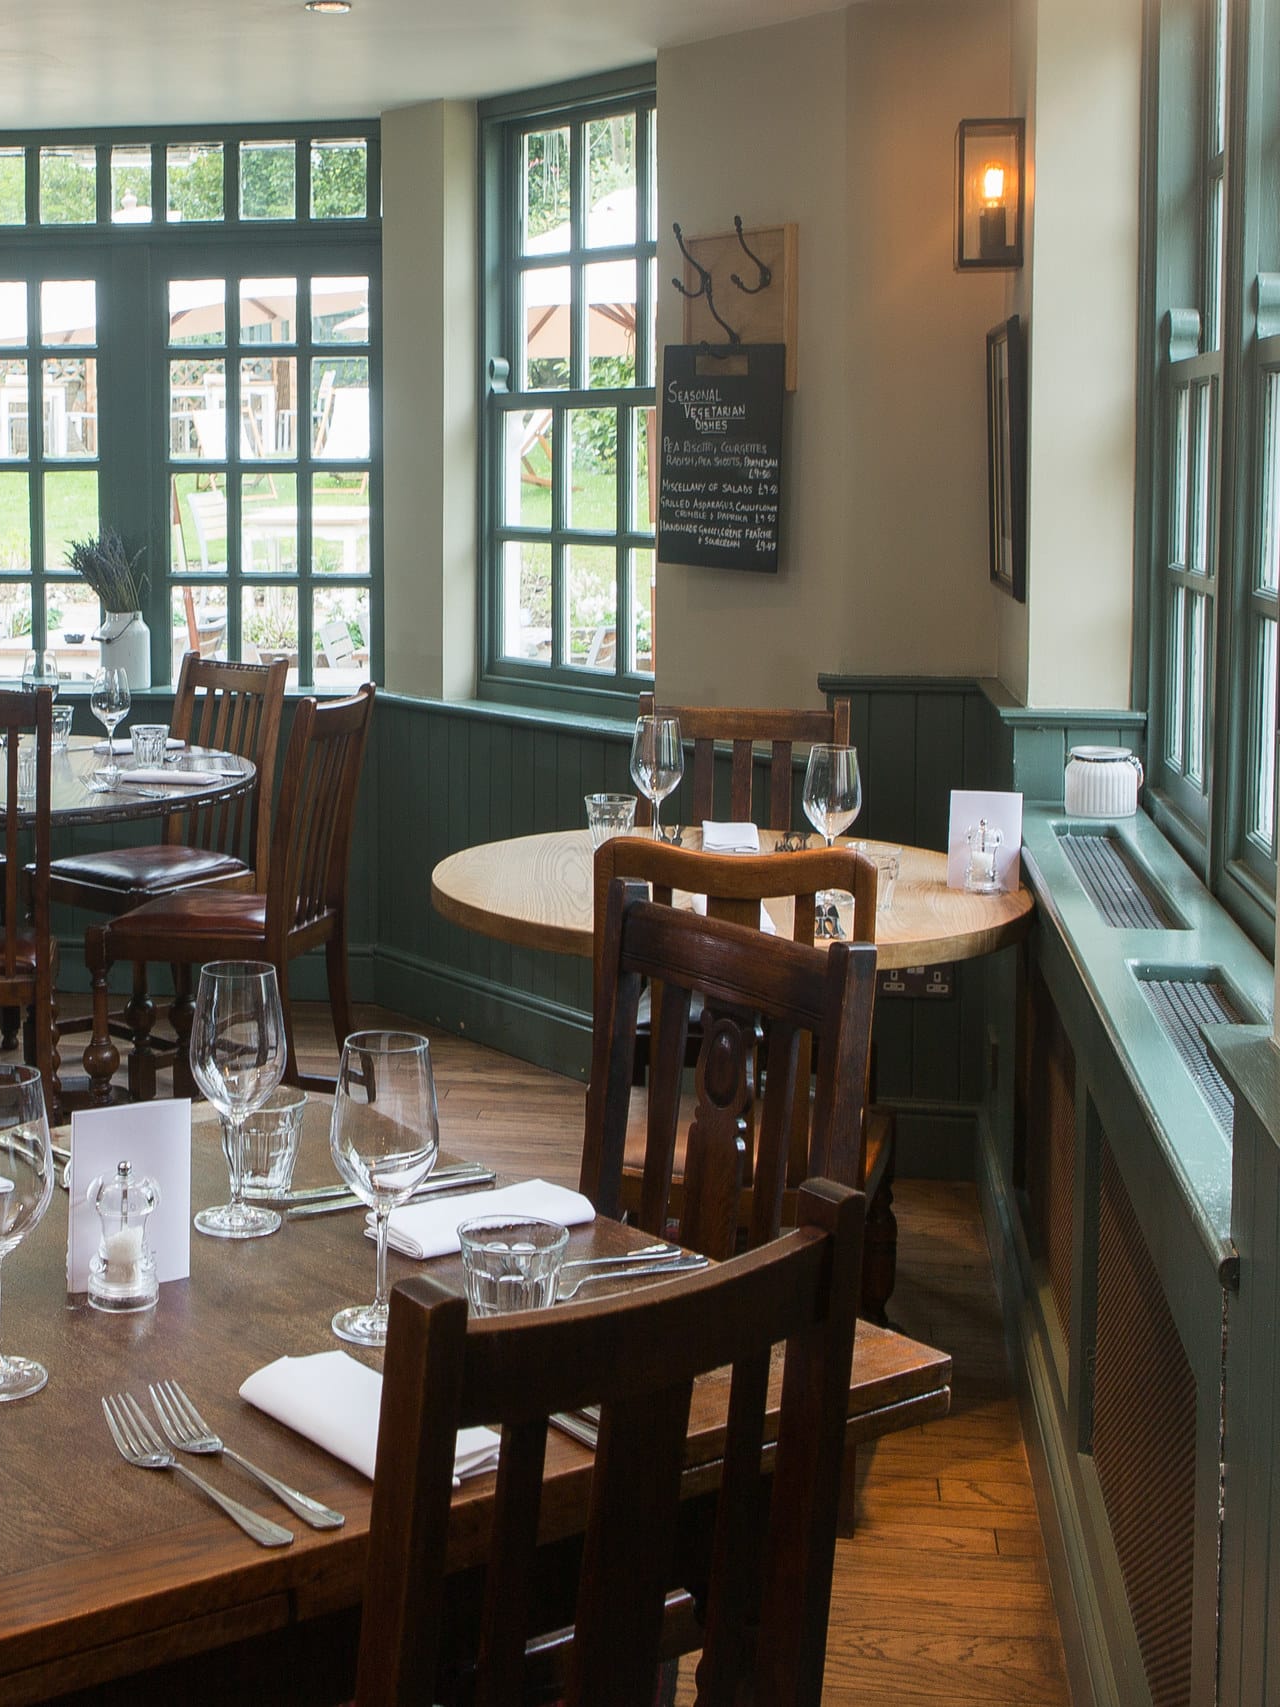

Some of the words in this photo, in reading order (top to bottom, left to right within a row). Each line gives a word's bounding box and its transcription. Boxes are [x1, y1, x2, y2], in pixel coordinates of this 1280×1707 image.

[668, 380, 722, 403] SEASONAL
[684, 403, 746, 419] VEGETARIAN
[695, 418, 728, 430] DISHES
[663, 436, 680, 453] PEA
[720, 441, 768, 455] COURGETTES
[662, 479, 706, 493] MISCELLANY
[708, 483, 719, 492] OF
[722, 483, 753, 494] SALADS
[661, 496, 690, 508] GRILLED
